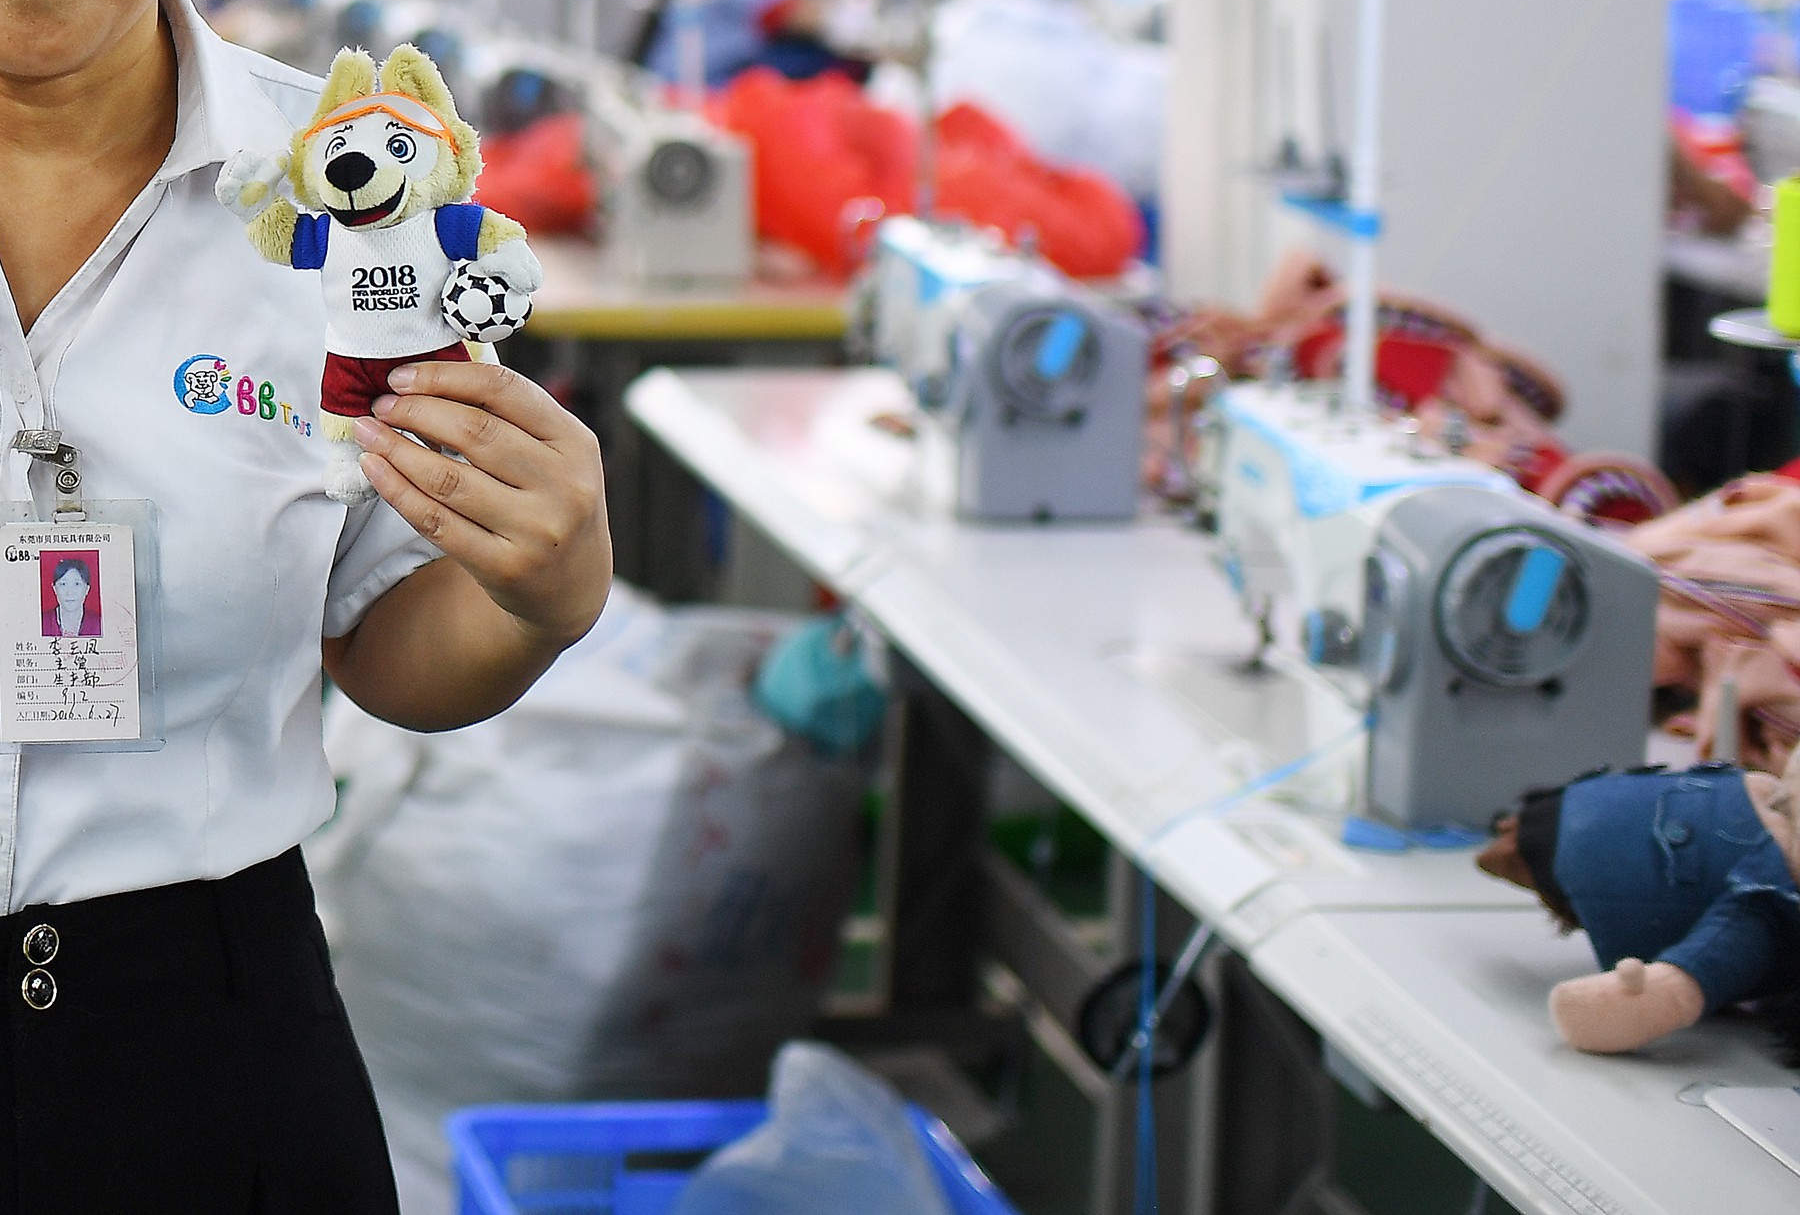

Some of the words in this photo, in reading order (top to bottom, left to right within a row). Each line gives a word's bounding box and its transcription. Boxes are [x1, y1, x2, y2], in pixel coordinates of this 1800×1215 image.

[352, 265, 416, 288] 2018
[370, 288, 399, 296] WORLD
[353, 296, 418, 311] RUSSIA
